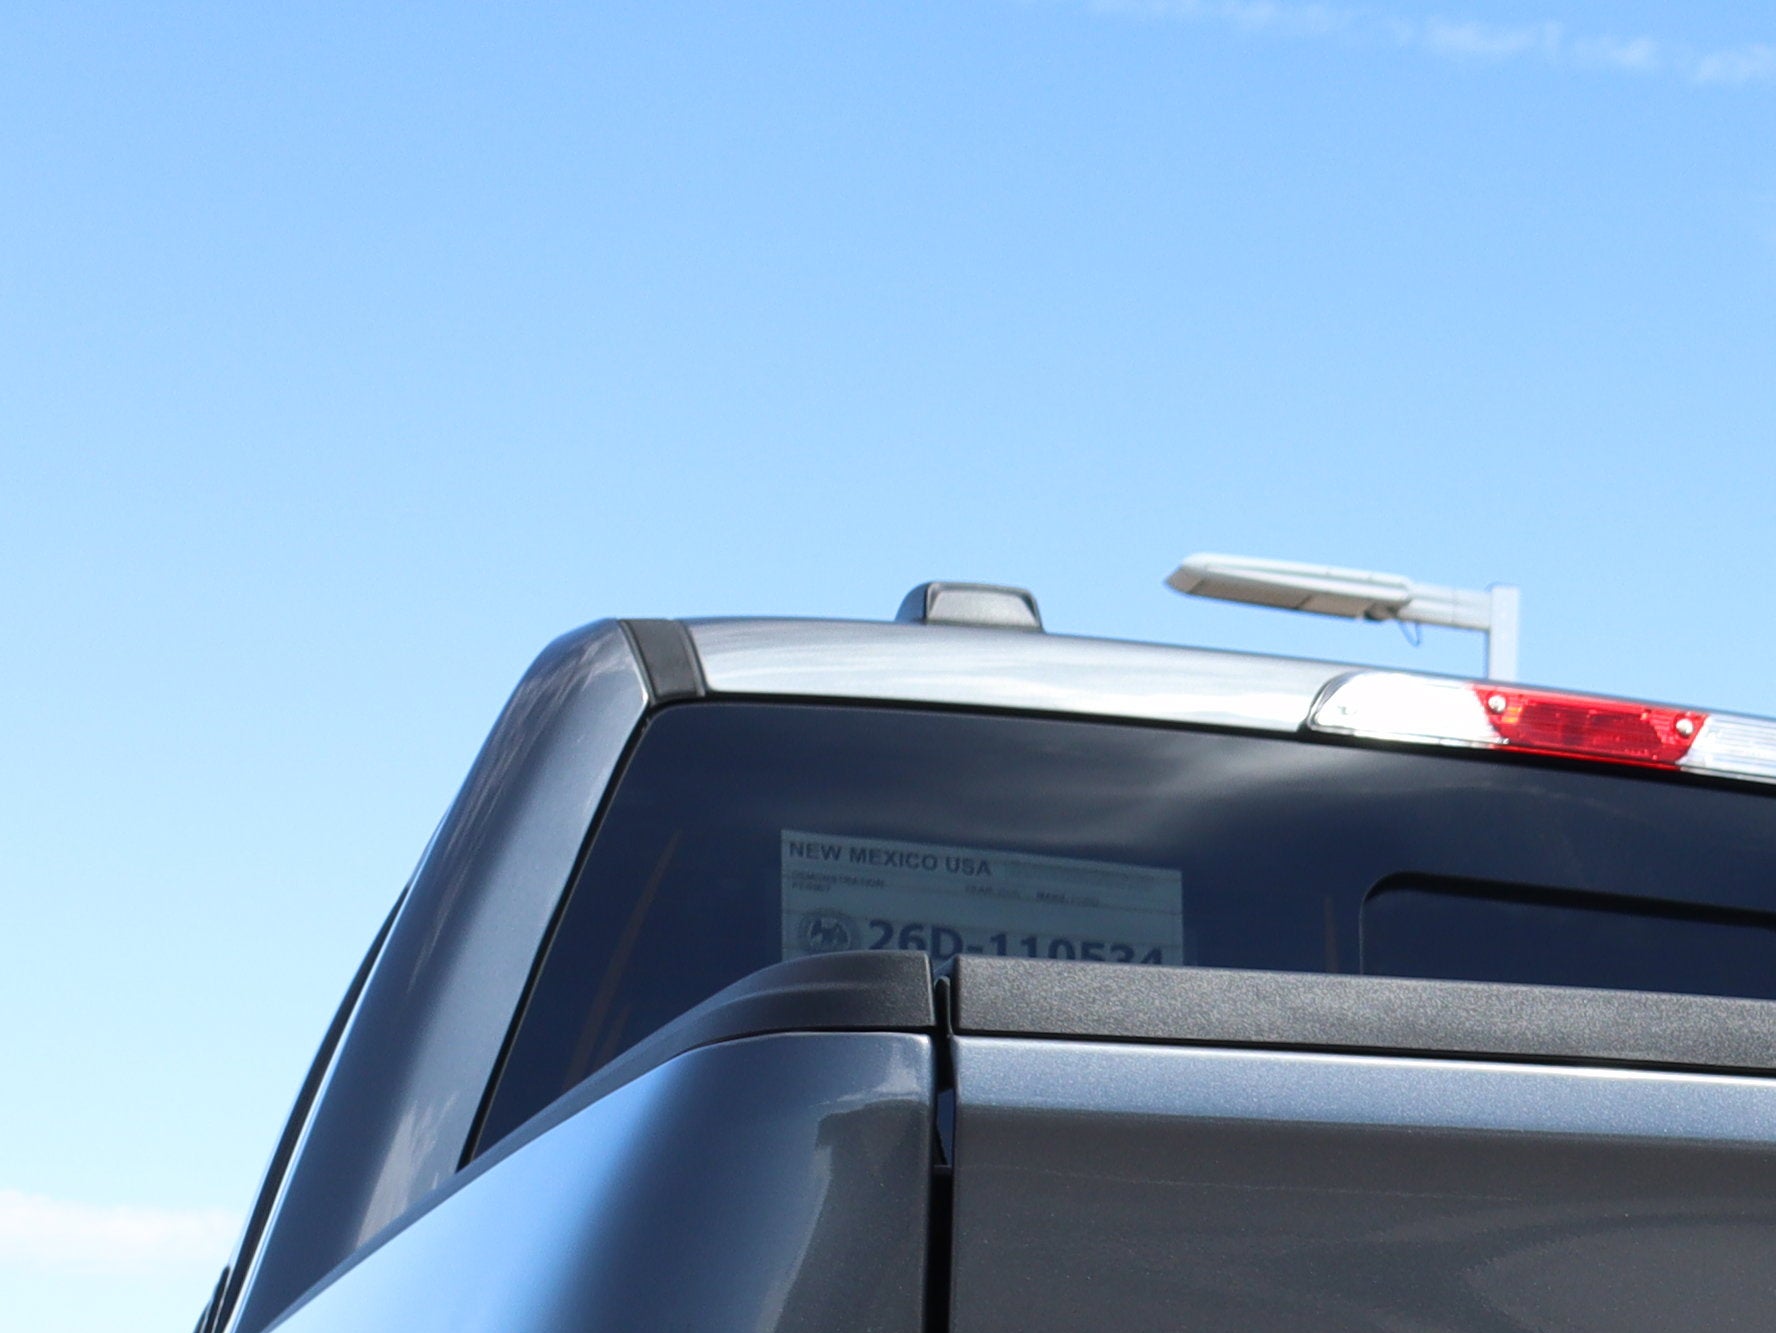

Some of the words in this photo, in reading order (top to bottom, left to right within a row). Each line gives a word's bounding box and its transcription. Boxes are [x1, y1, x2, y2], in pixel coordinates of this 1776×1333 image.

[789, 841, 842, 861] NEW
[849, 846, 938, 872] MEXICO
[945, 856, 992, 876] USA
